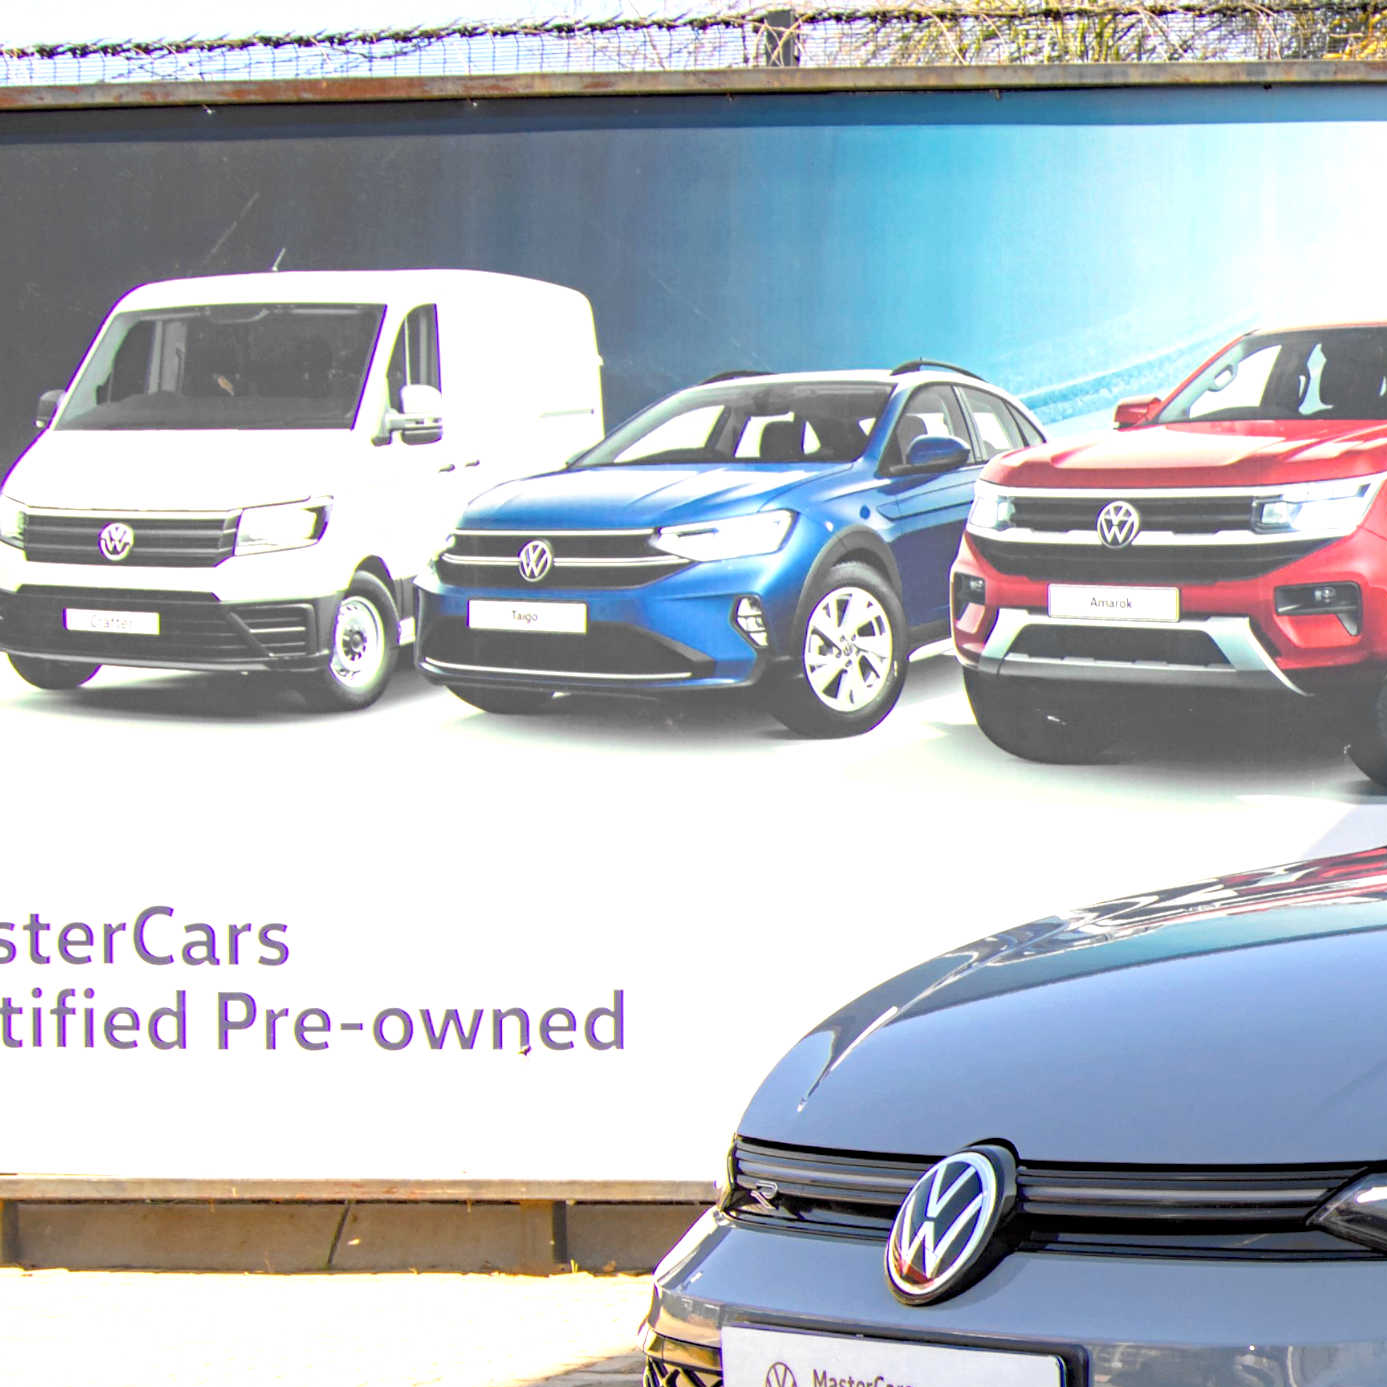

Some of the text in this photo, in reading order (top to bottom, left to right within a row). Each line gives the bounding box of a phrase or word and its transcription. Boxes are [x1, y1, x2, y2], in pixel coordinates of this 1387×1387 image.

[512, 609, 538, 624] Taigo
[1090, 597, 1132, 608] Amarok
[0, 905, 290, 967] sterCars
[0, 987, 625, 1051] tified Pre-owned
